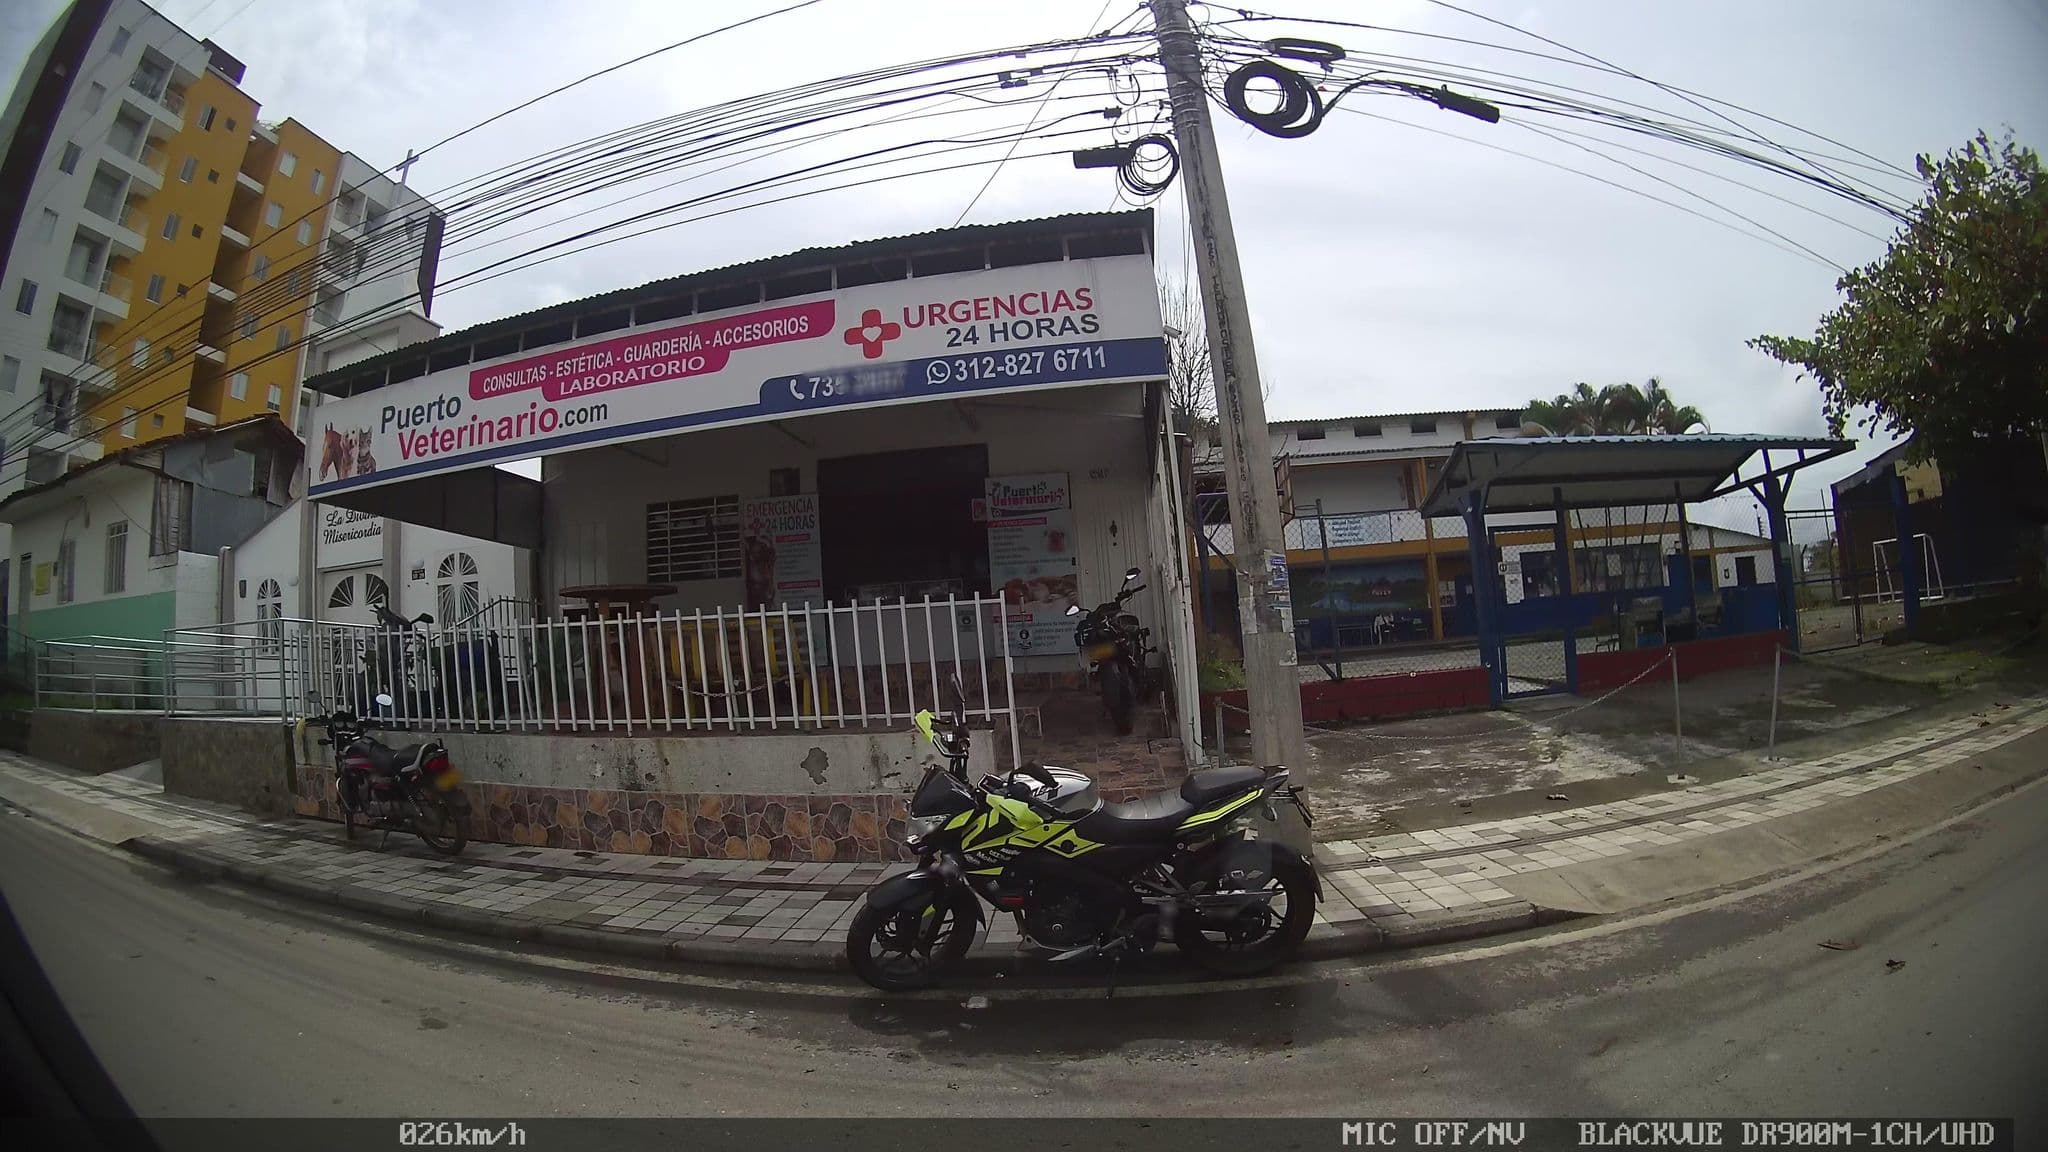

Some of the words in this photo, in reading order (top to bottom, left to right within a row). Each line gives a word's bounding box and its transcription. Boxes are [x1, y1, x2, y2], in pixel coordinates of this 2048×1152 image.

[903, 287, 1094, 329] URGENCIAS
[946, 326, 980, 349] 24
[989, 312, 1100, 344] HORAS
[483, 367, 548, 393] CONSULTAS
[556, 350, 614, 379] ESTÉTICA
[624, 330, 702, 364] GUARDERÍA
[712, 315, 809, 346] ACCESORIOS
[955, 351, 1044, 382] 312-827
[1053, 346, 1107, 373] 6711
[560, 354, 706, 396] LABORATORIO
[381, 393, 461, 434] Puerto
[326, 510, 343, 527] La
[746, 498, 814, 517] EMERGENCIA
[778, 514, 816, 531] HORAS
[323, 521, 382, 545] Misericordia
